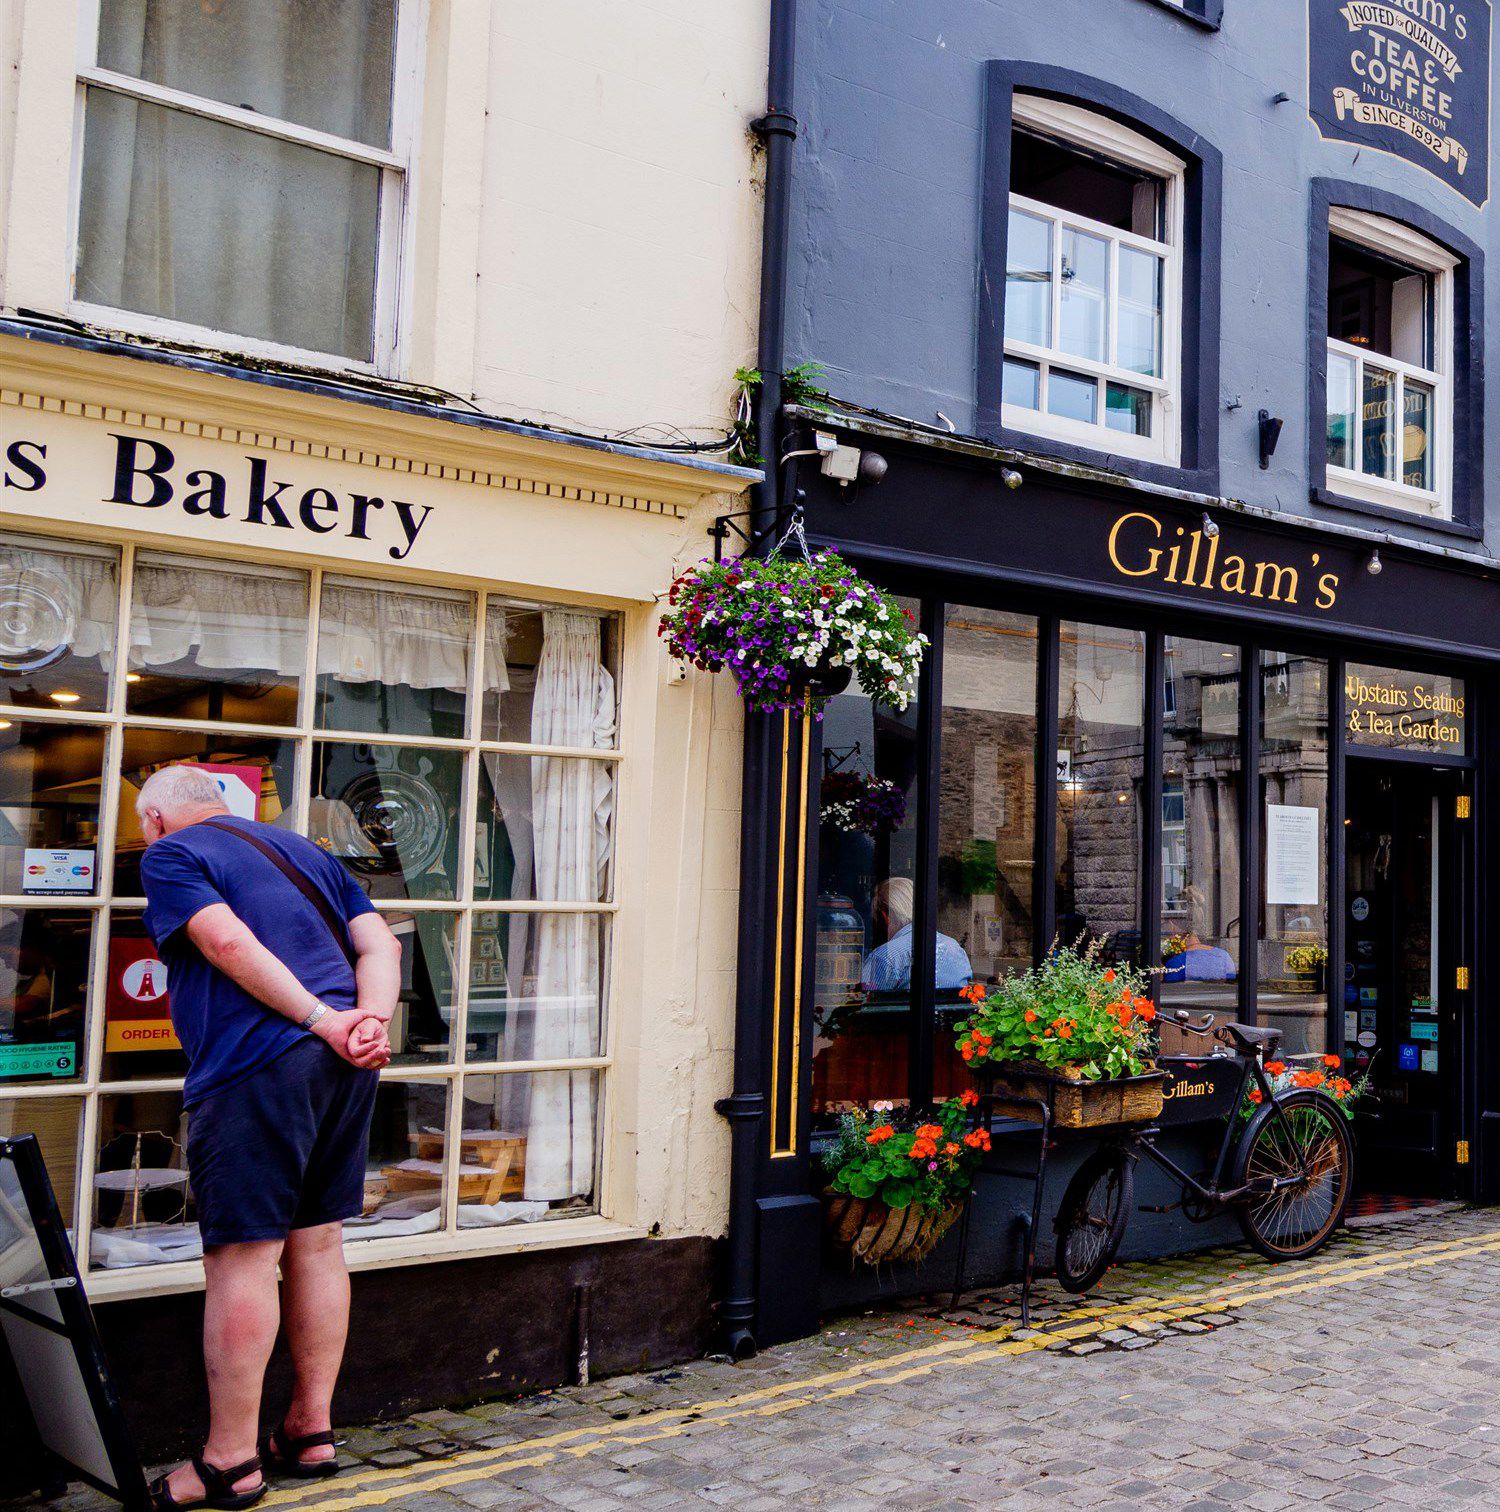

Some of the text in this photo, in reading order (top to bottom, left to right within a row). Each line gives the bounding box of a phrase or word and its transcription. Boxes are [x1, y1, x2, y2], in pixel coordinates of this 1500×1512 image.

[1353, 5, 1454, 66] NOTED for QUALITY
[1368, 30, 1439, 84] TEA &
[1351, 50, 1452, 118] COFFEE
[1362, 82, 1446, 131] IN ULVERSTON
[1363, 105, 1442, 154] SINCE 1892
[4, 433, 434, 560] s Bakery
[1108, 512, 1339, 609] Gillam's
[1347, 676, 1465, 718] Upstairs Seating
[1349, 709, 1460, 743] & Tea Garden
[122, 1029, 170, 1039] ORDER
